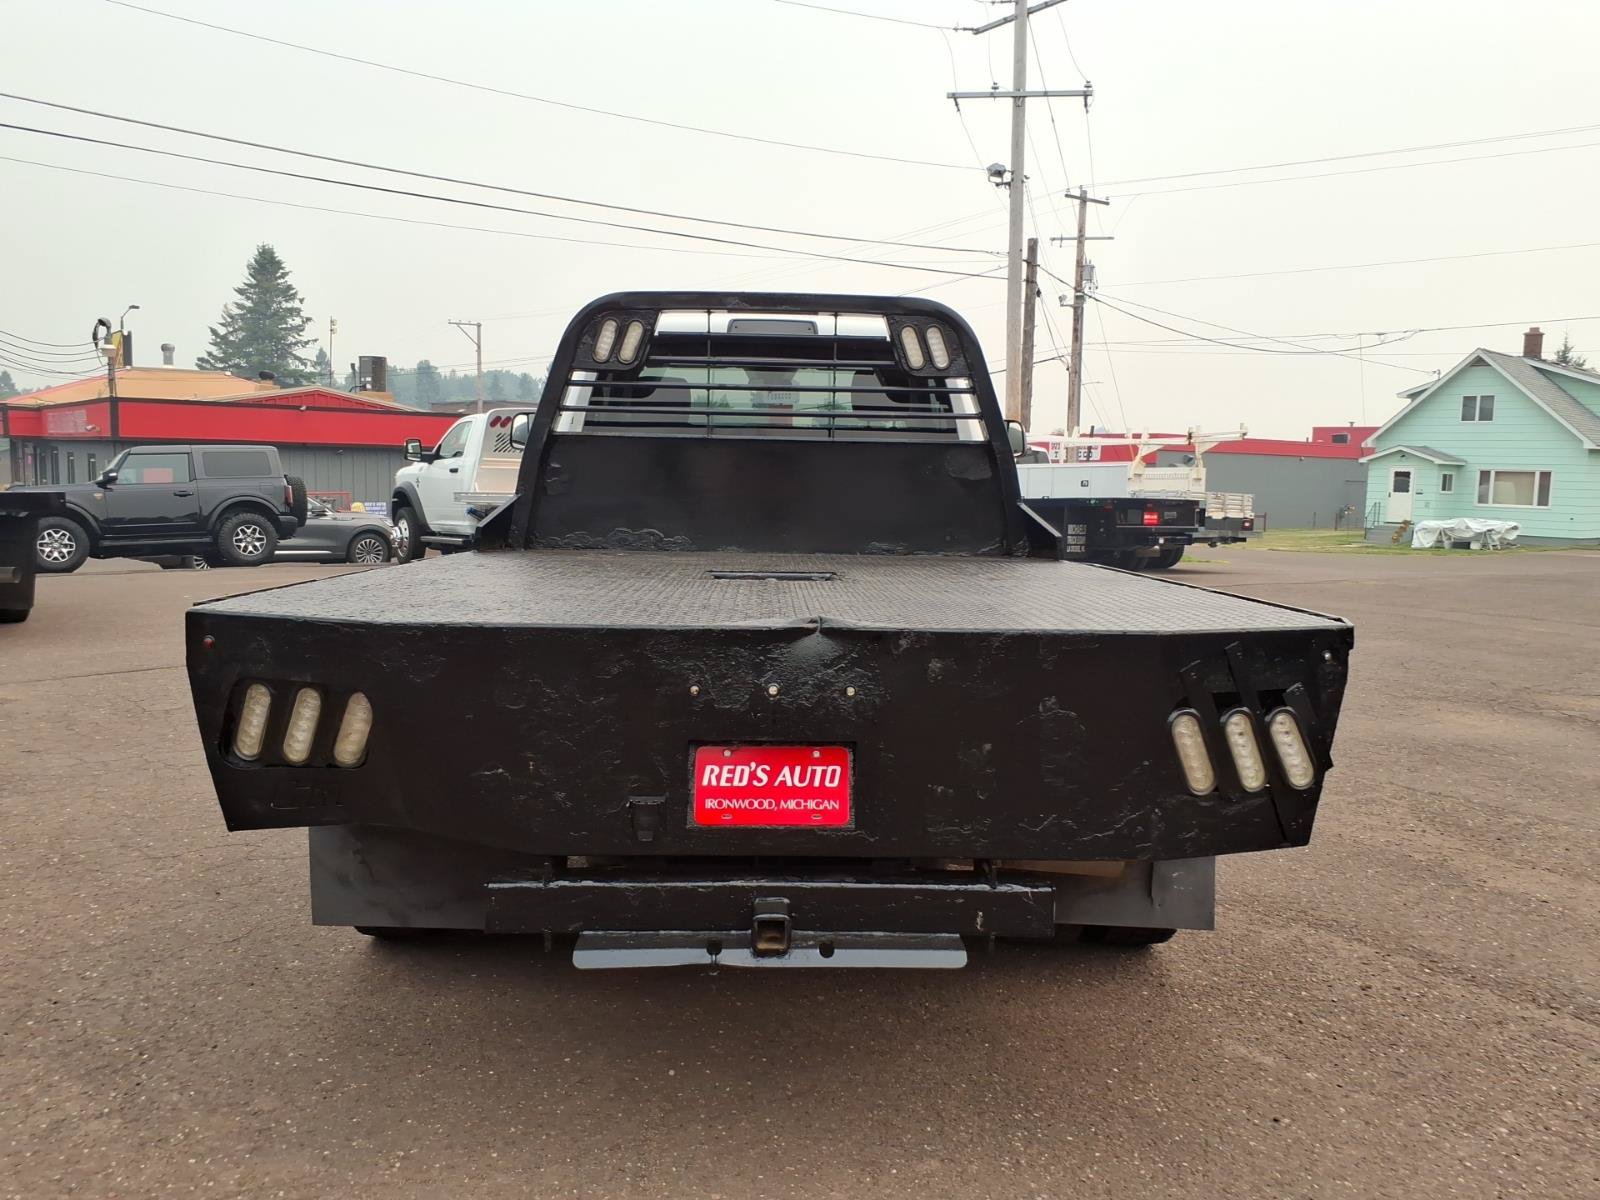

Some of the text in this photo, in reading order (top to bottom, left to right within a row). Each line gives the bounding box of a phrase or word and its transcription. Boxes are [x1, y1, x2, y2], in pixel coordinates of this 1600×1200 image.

[702, 761, 842, 788] RED'S AUTO
[705, 798, 839, 811] IRONWOOD, MICHIGAN
